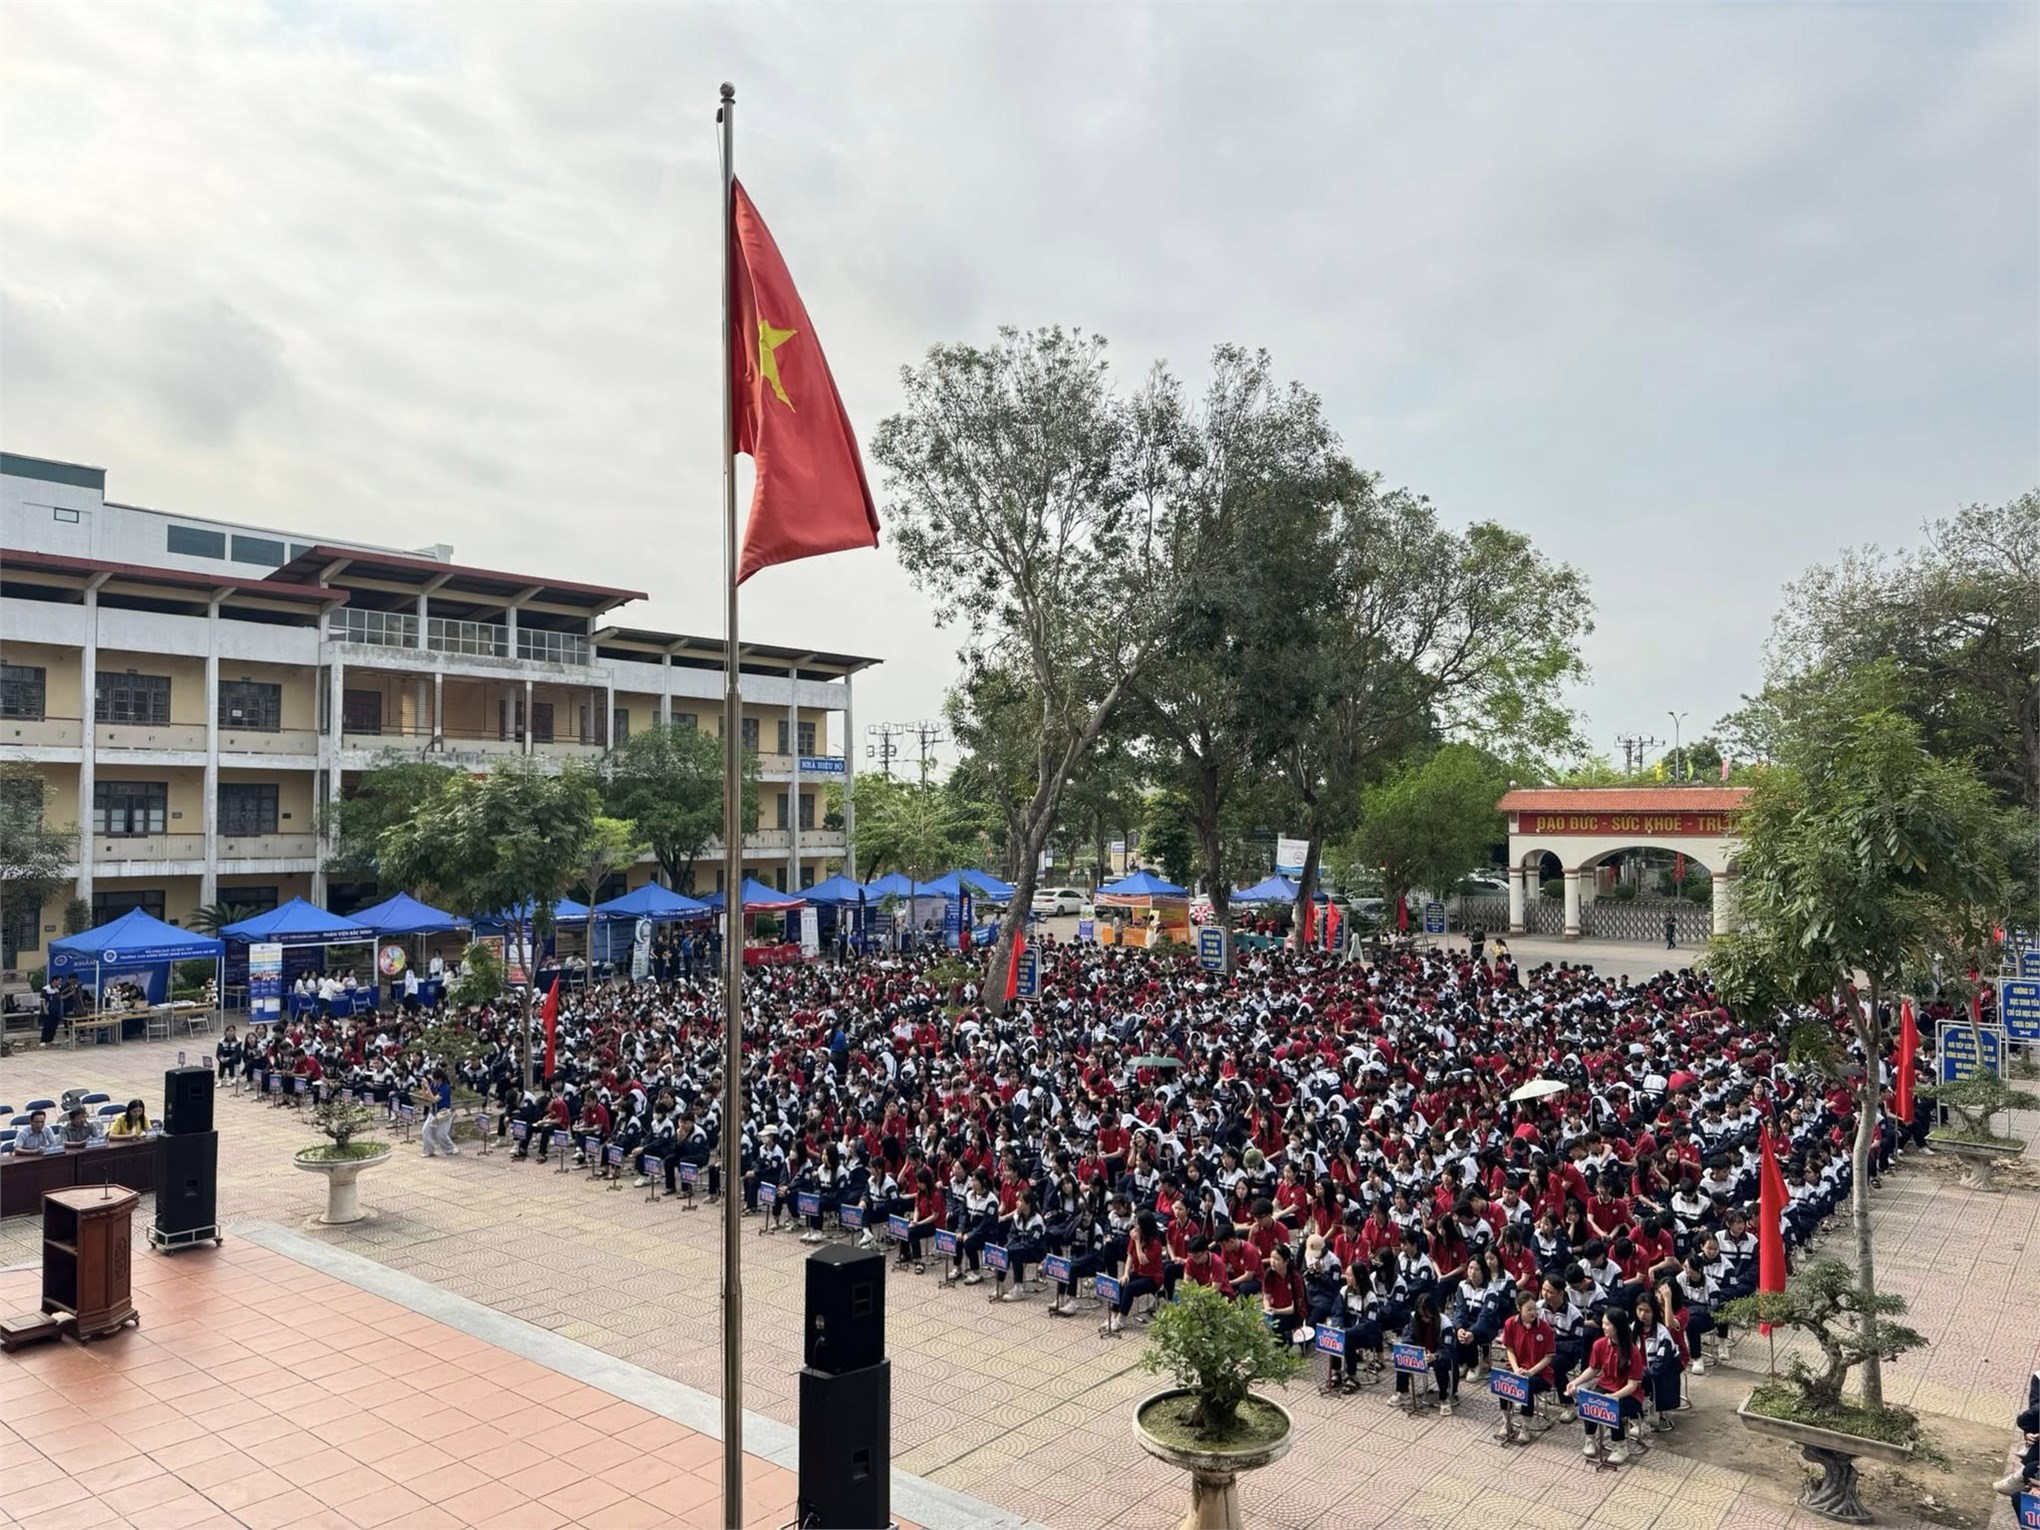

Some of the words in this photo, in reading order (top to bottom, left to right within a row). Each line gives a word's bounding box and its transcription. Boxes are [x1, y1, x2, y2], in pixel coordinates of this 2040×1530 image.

[1536, 816, 1565, 832] ĐẠO
[1569, 815, 1598, 830] ĐỨC
[1611, 815, 1640, 830] SỨC
[2013, 986, 2029, 995] KHÔNG
[2029, 987, 2036, 996] CÓ
[2009, 998, 2019, 1006] HỌC
[1493, 1380, 1525, 1400] 10A5
[1582, 1402, 1617, 1423] 10A6
